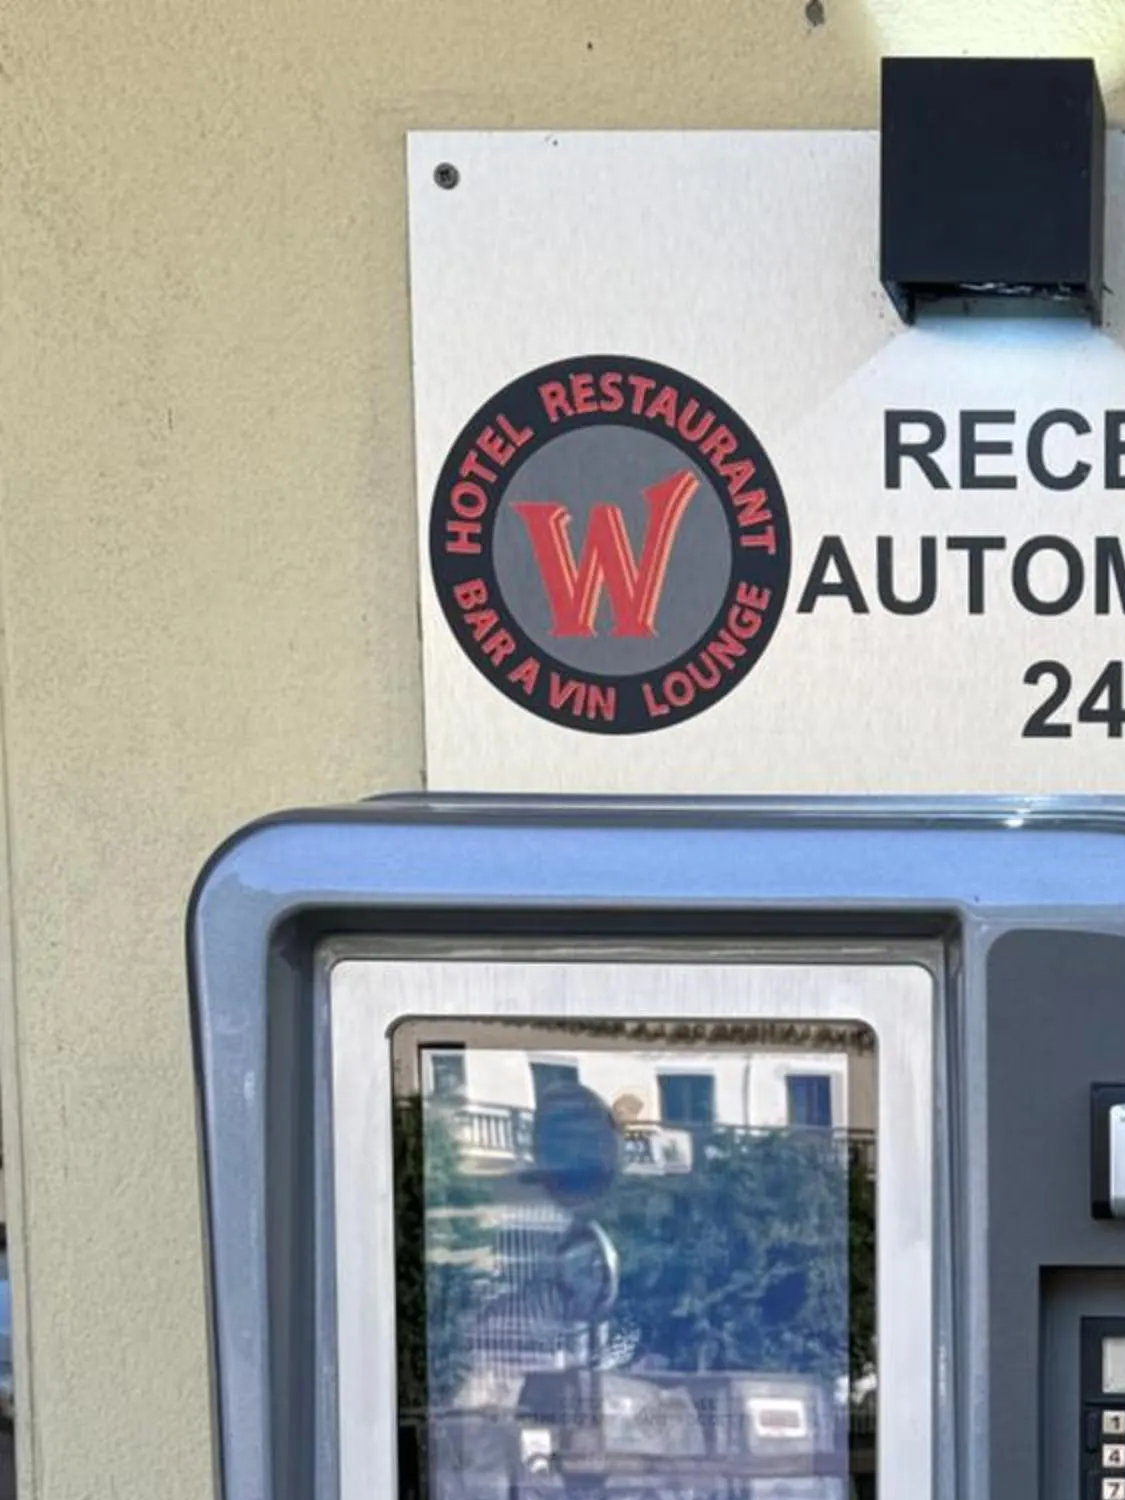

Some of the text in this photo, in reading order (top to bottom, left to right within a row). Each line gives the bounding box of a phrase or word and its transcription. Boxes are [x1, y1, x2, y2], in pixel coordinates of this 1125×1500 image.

[445, 372, 777, 557] HOTEL RESTAURANT
[509, 470, 701, 639] W
[453, 578, 772, 721] BAR A VIN LOUNGE
[1108, 1450, 1120, 1464] 4
[1110, 1415, 1120, 1431] 1
[1108, 1482, 1120, 1498] 7
